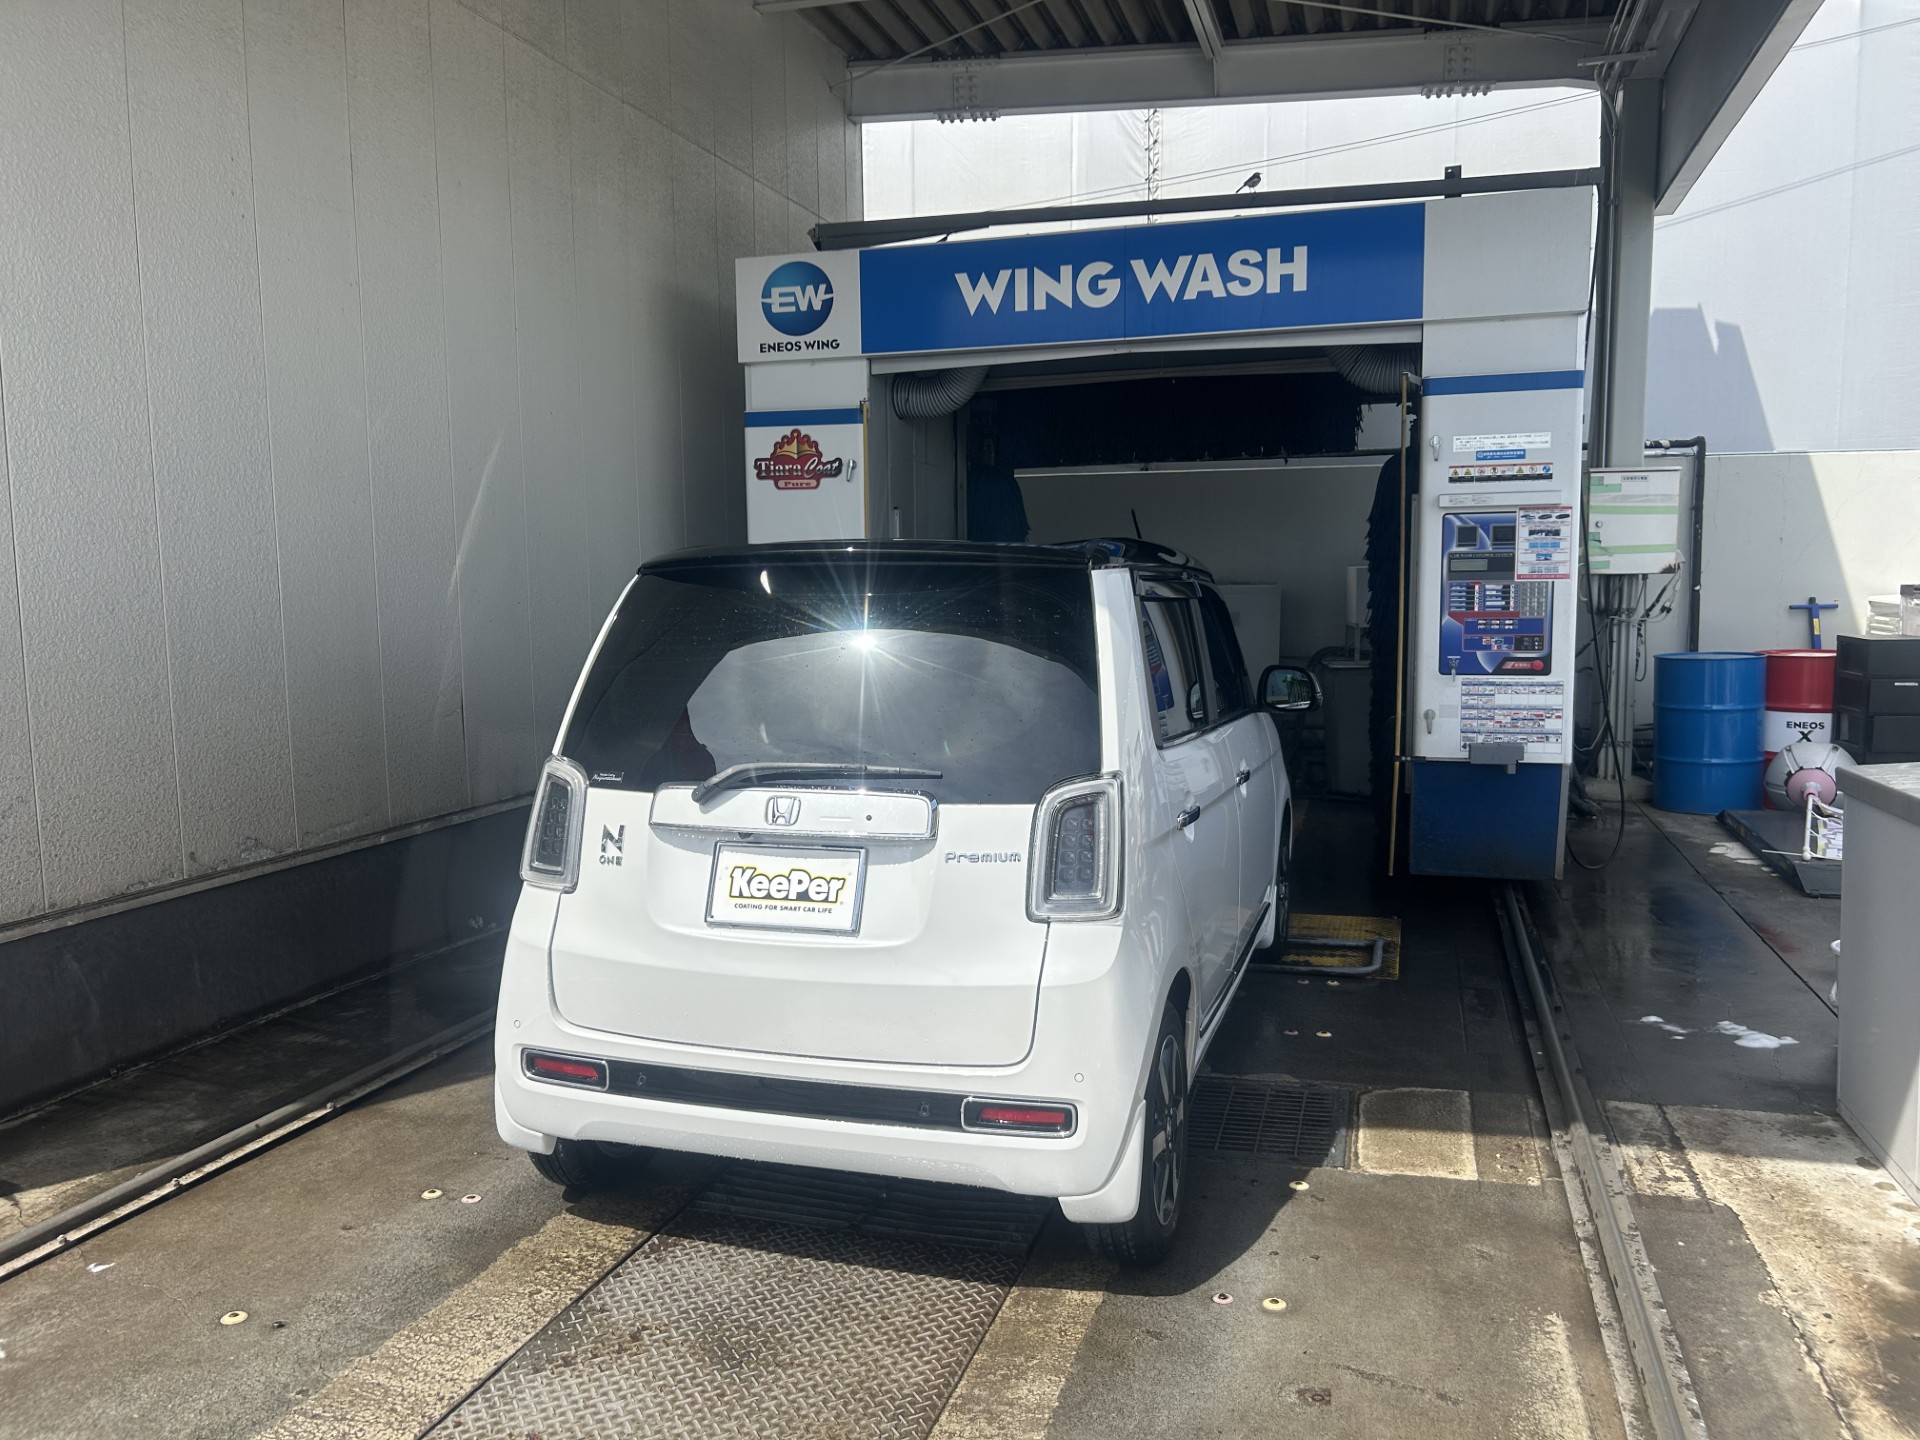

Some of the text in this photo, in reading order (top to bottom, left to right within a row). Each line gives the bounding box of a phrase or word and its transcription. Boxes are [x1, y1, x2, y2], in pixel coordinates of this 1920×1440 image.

[954, 245, 1308, 317] WING WASH
[770, 283, 827, 313] EW
[759, 339, 840, 353] ENEOS WING
[757, 457, 840, 479] Tiara Coat
[1786, 721, 1825, 729] ENEOS
[1796, 730, 1814, 743] X
[601, 824, 625, 855] N
[599, 855, 623, 866] ONE
[945, 851, 1021, 863] Premium
[729, 866, 846, 904] KeePer
